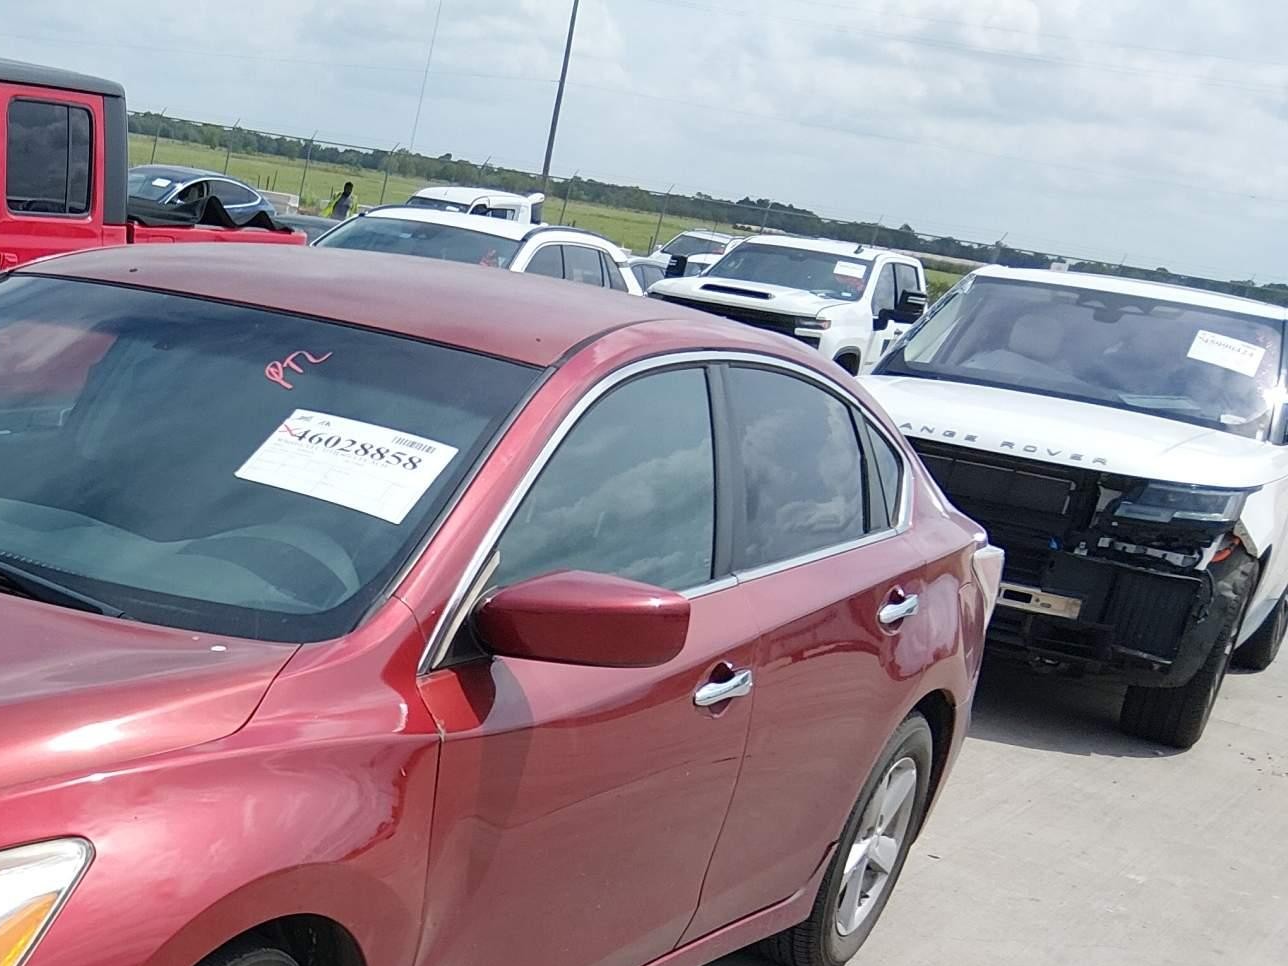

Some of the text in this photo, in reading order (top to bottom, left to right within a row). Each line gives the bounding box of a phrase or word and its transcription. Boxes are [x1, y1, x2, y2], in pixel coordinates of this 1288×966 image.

[294, 428, 423, 471] 46028858
[898, 421, 1109, 466] ANGE ROVER
